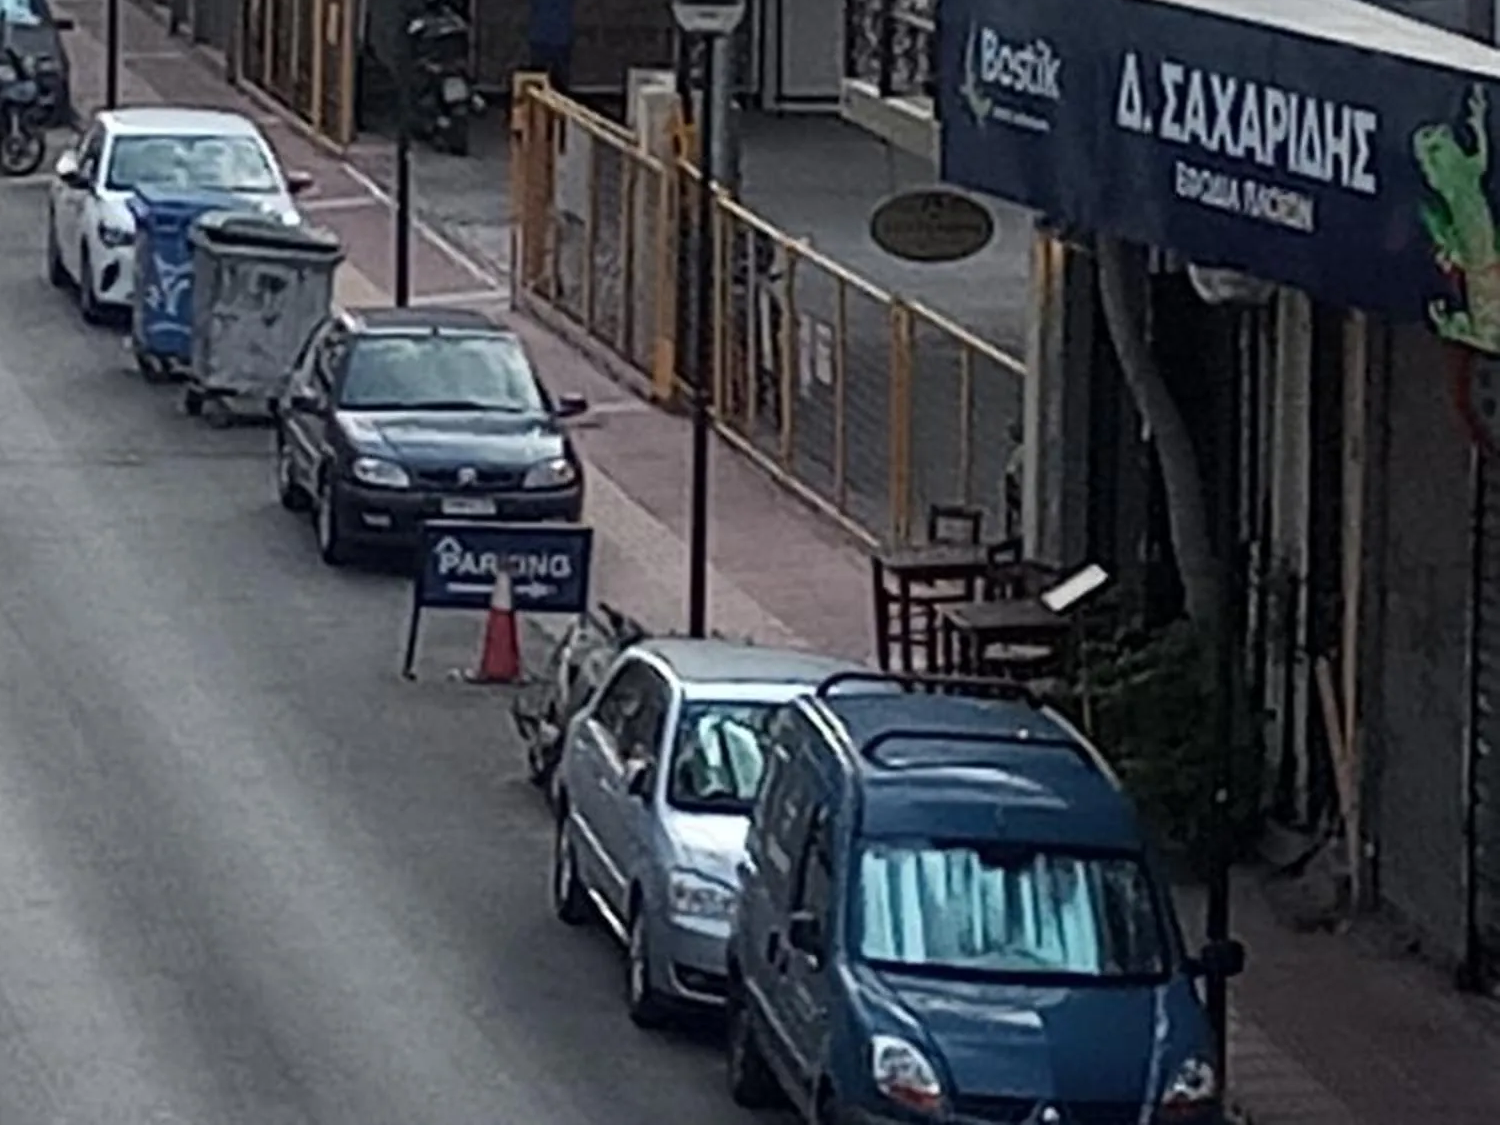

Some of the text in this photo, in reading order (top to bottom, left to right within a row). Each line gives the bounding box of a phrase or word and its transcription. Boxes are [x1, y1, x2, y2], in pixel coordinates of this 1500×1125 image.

[981, 26, 1062, 99] Bostik
[1116, 52, 1380, 195] Δ. ΣΑΧΑΡΙΔΗΣ
